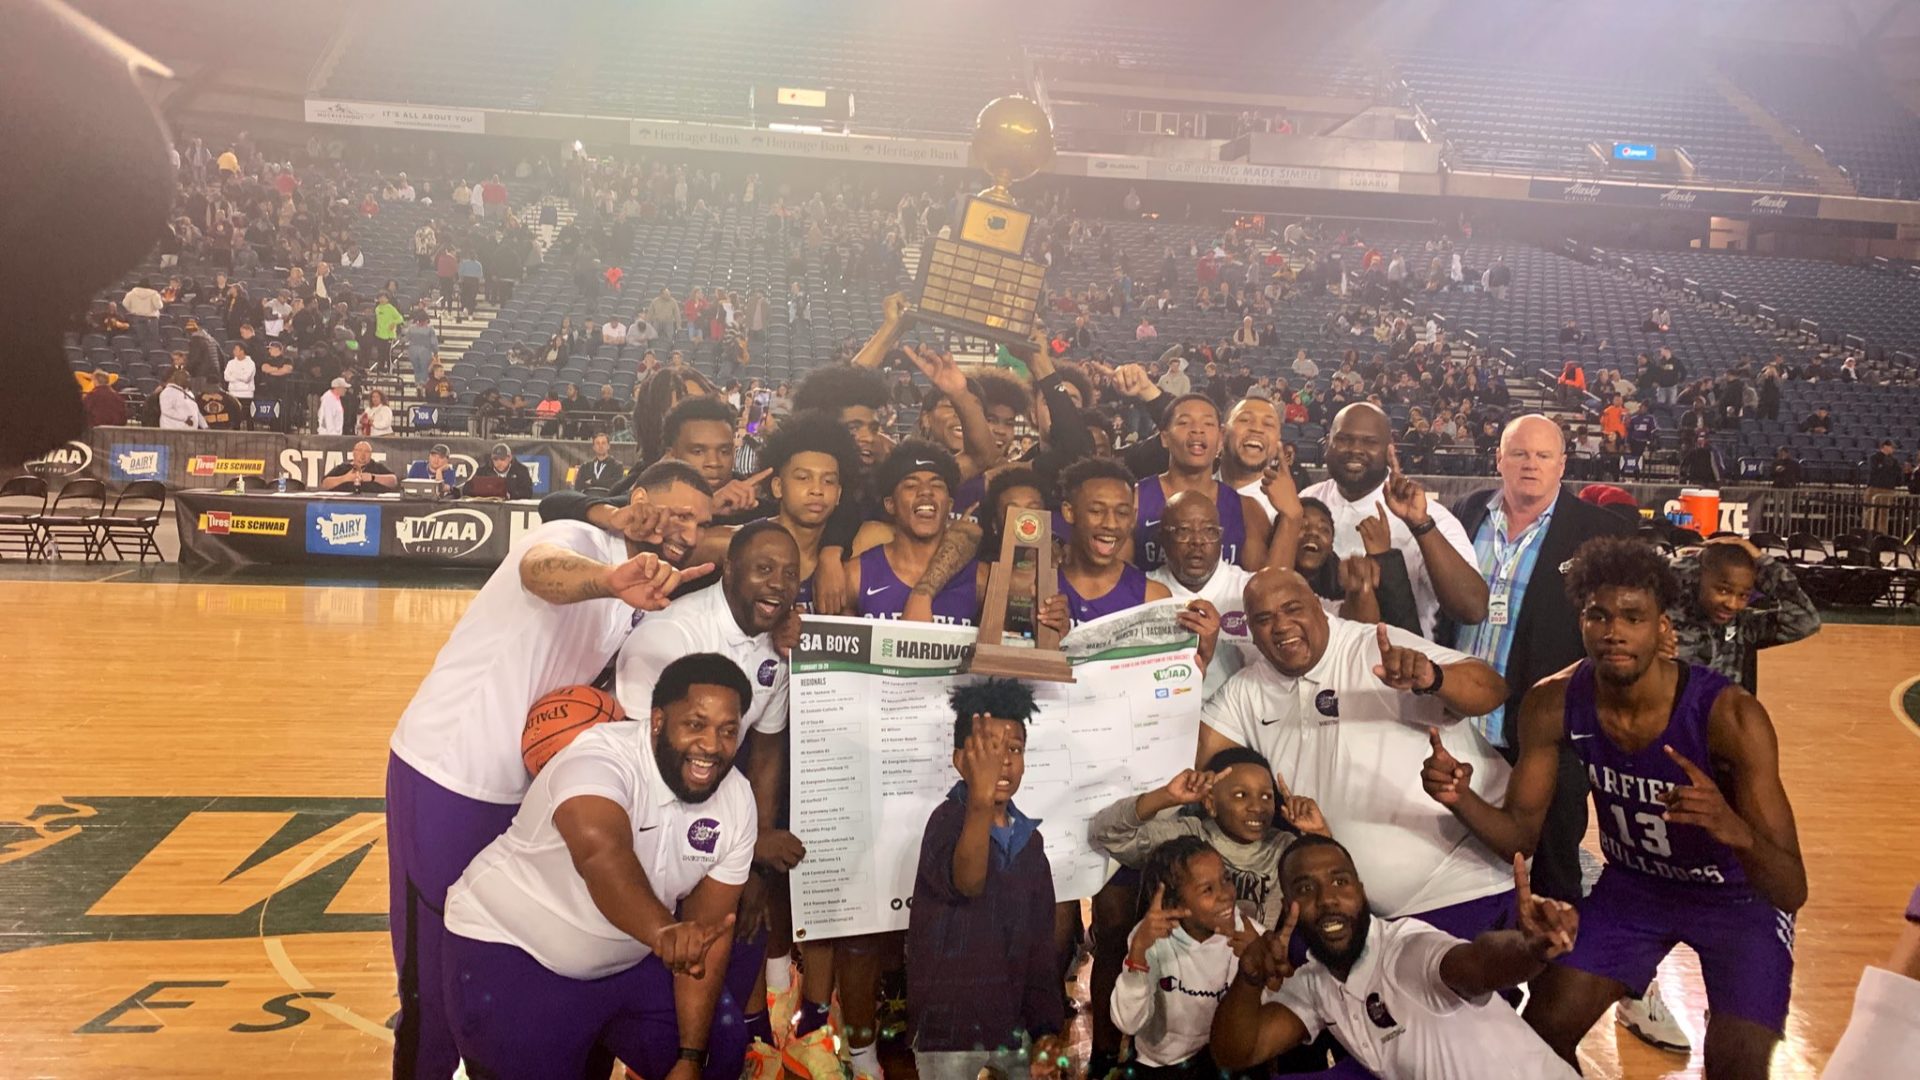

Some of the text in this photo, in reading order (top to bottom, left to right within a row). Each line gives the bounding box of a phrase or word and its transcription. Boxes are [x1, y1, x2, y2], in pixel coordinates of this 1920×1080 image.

[402, 111, 420, 121] ALL
[422, 112, 450, 122] ABOUT
[452, 114, 473, 123] YOU
[654, 127, 741, 146] Heritage Bank
[766, 135, 850, 153] Heritage Bank
[877, 143, 960, 161] Heritage Bank
[1242, 166, 1276, 179] MADE
[1563, 183, 1601, 197] Alaska
[1659, 189, 1696, 203] Alaska
[1751, 195, 1788, 209] Alaska
[259, 405, 271, 414] 107
[130, 454, 154, 469] DAIRY
[195, 457, 263, 472] Tires LES SCHWAB
[207, 512, 286, 532] Tires LES SCHWAB
[332, 518, 361, 537] DAIRY
[411, 519, 478, 541] WIAA
[436, 545, 460, 554] 1905
[1146, 625, 1172, 636] TACOMA
[800, 632, 860, 655] 3A BOYS
[881, 638, 894, 658] 2020
[1159, 667, 1187, 680] WIAA
[800, 677, 827, 687] REGIONALS
[1610, 803, 1672, 858] 13
[1159, 975, 1231, 1002] Champi
